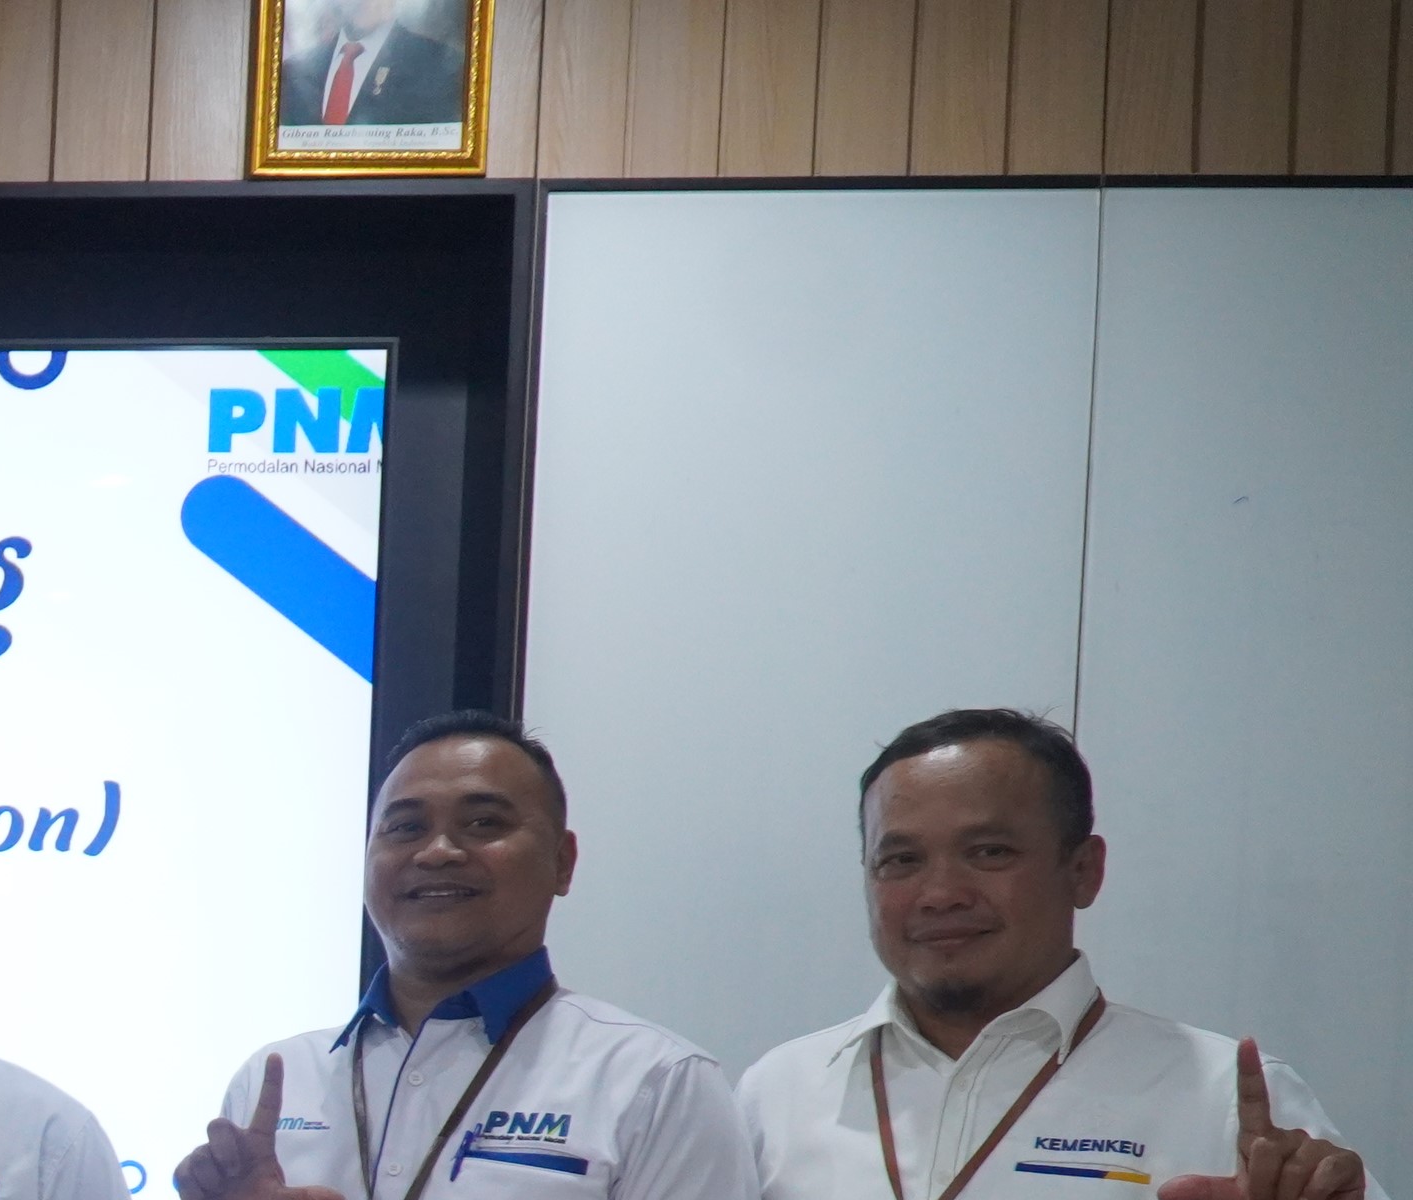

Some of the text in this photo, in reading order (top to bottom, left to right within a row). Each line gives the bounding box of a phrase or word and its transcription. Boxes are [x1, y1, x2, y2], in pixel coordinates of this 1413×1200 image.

[282, 128, 319, 139] Gibran
[207, 459, 298, 475] Permodalan
[304, 459, 371, 475] Nasional
[483, 1110, 572, 1137] PNM
[1034, 1136, 1145, 1158] KEMENKEU
